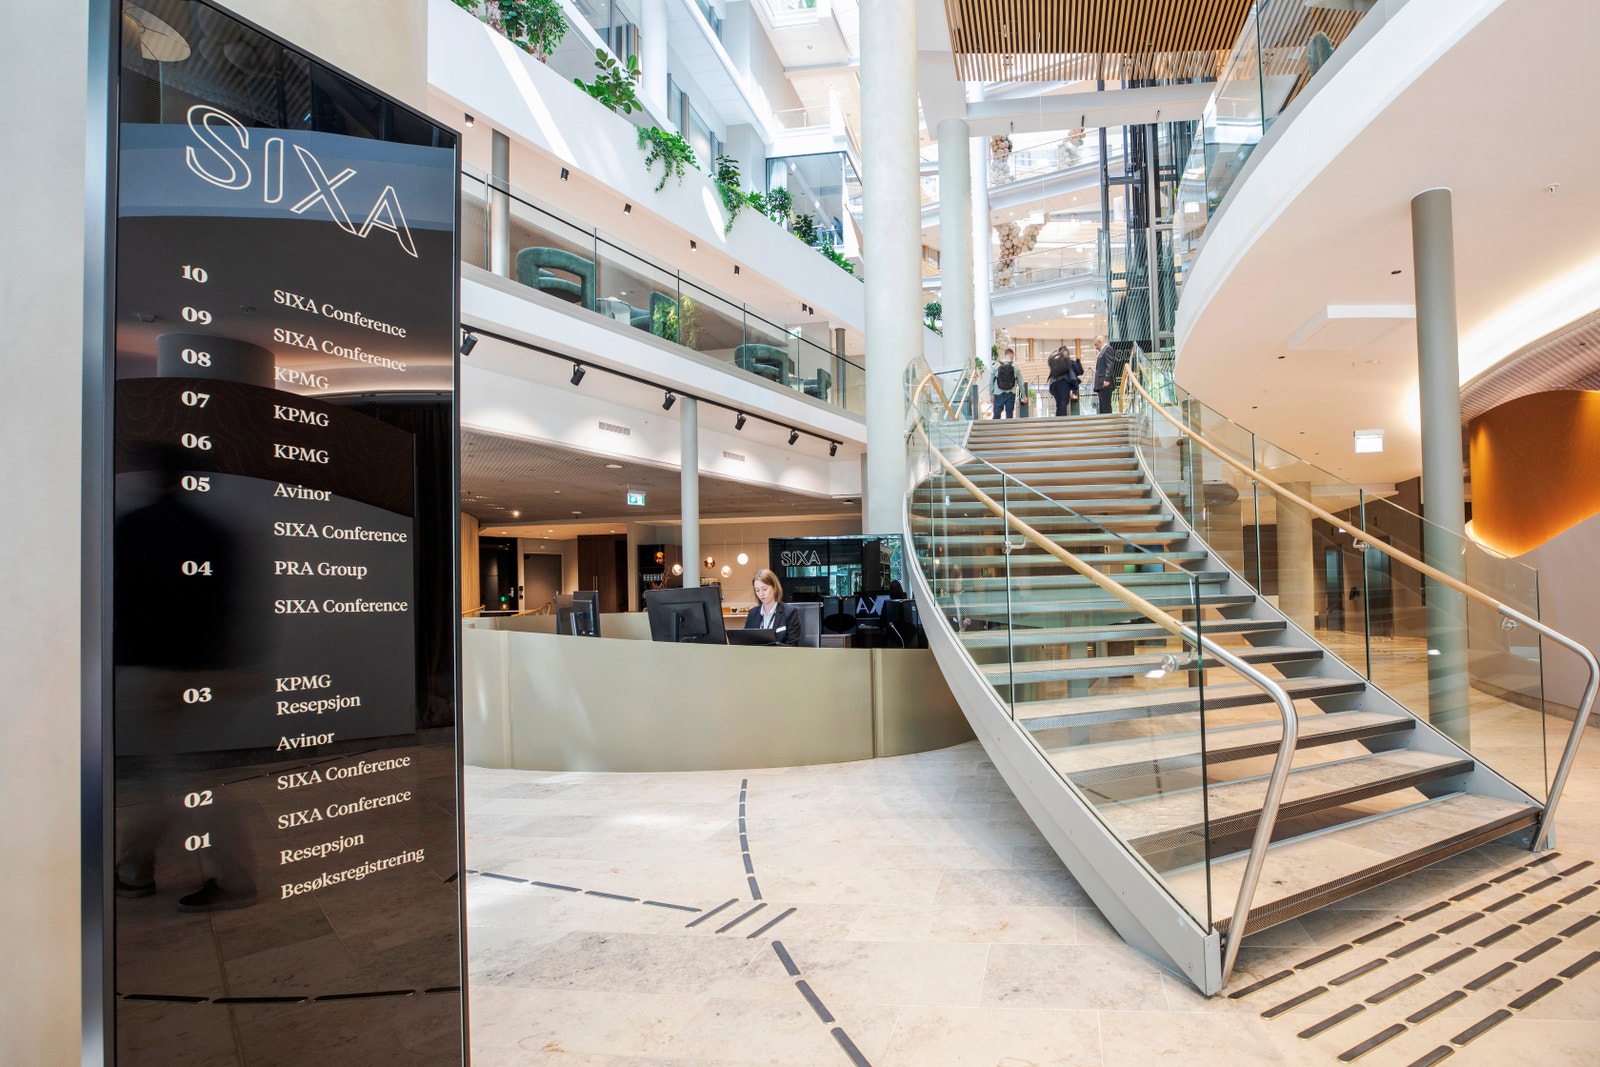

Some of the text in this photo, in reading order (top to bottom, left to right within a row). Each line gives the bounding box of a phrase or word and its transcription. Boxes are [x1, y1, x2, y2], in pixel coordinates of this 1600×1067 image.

[186, 105, 418, 258] SIXA
[181, 264, 209, 284] 10
[181, 306, 213, 326] 09
[273, 289, 407, 338] SIXA Conference
[181, 348, 212, 368] 08
[273, 327, 407, 372] SIXA Conference
[273, 365, 331, 391] KPMG
[181, 390, 211, 409] 07
[273, 404, 330, 427] KPMG
[181, 432, 213, 451] 06
[273, 443, 330, 464] KPMG
[180, 475, 211, 493] 05
[273, 482, 333, 502] Avinor
[273, 521, 408, 543] SIXA Conference
[780, 550, 821, 566] SIXA
[181, 560, 214, 577] 04
[274, 560, 368, 580] PRA Group
[274, 597, 409, 614] SIXA Conference
[275, 673, 332, 693] KPMG
[182, 687, 213, 704] 03
[275, 694, 362, 716] Resepsjon
[276, 732, 335, 752] Avinor
[277, 756, 411, 791] SIXA Conference
[183, 789, 214, 809] 02
[277, 790, 412, 830] SIXA Conference
[184, 832, 212, 852] 01
[279, 833, 365, 866] Resepsjon
[279, 847, 426, 901] Besøksregistrering
